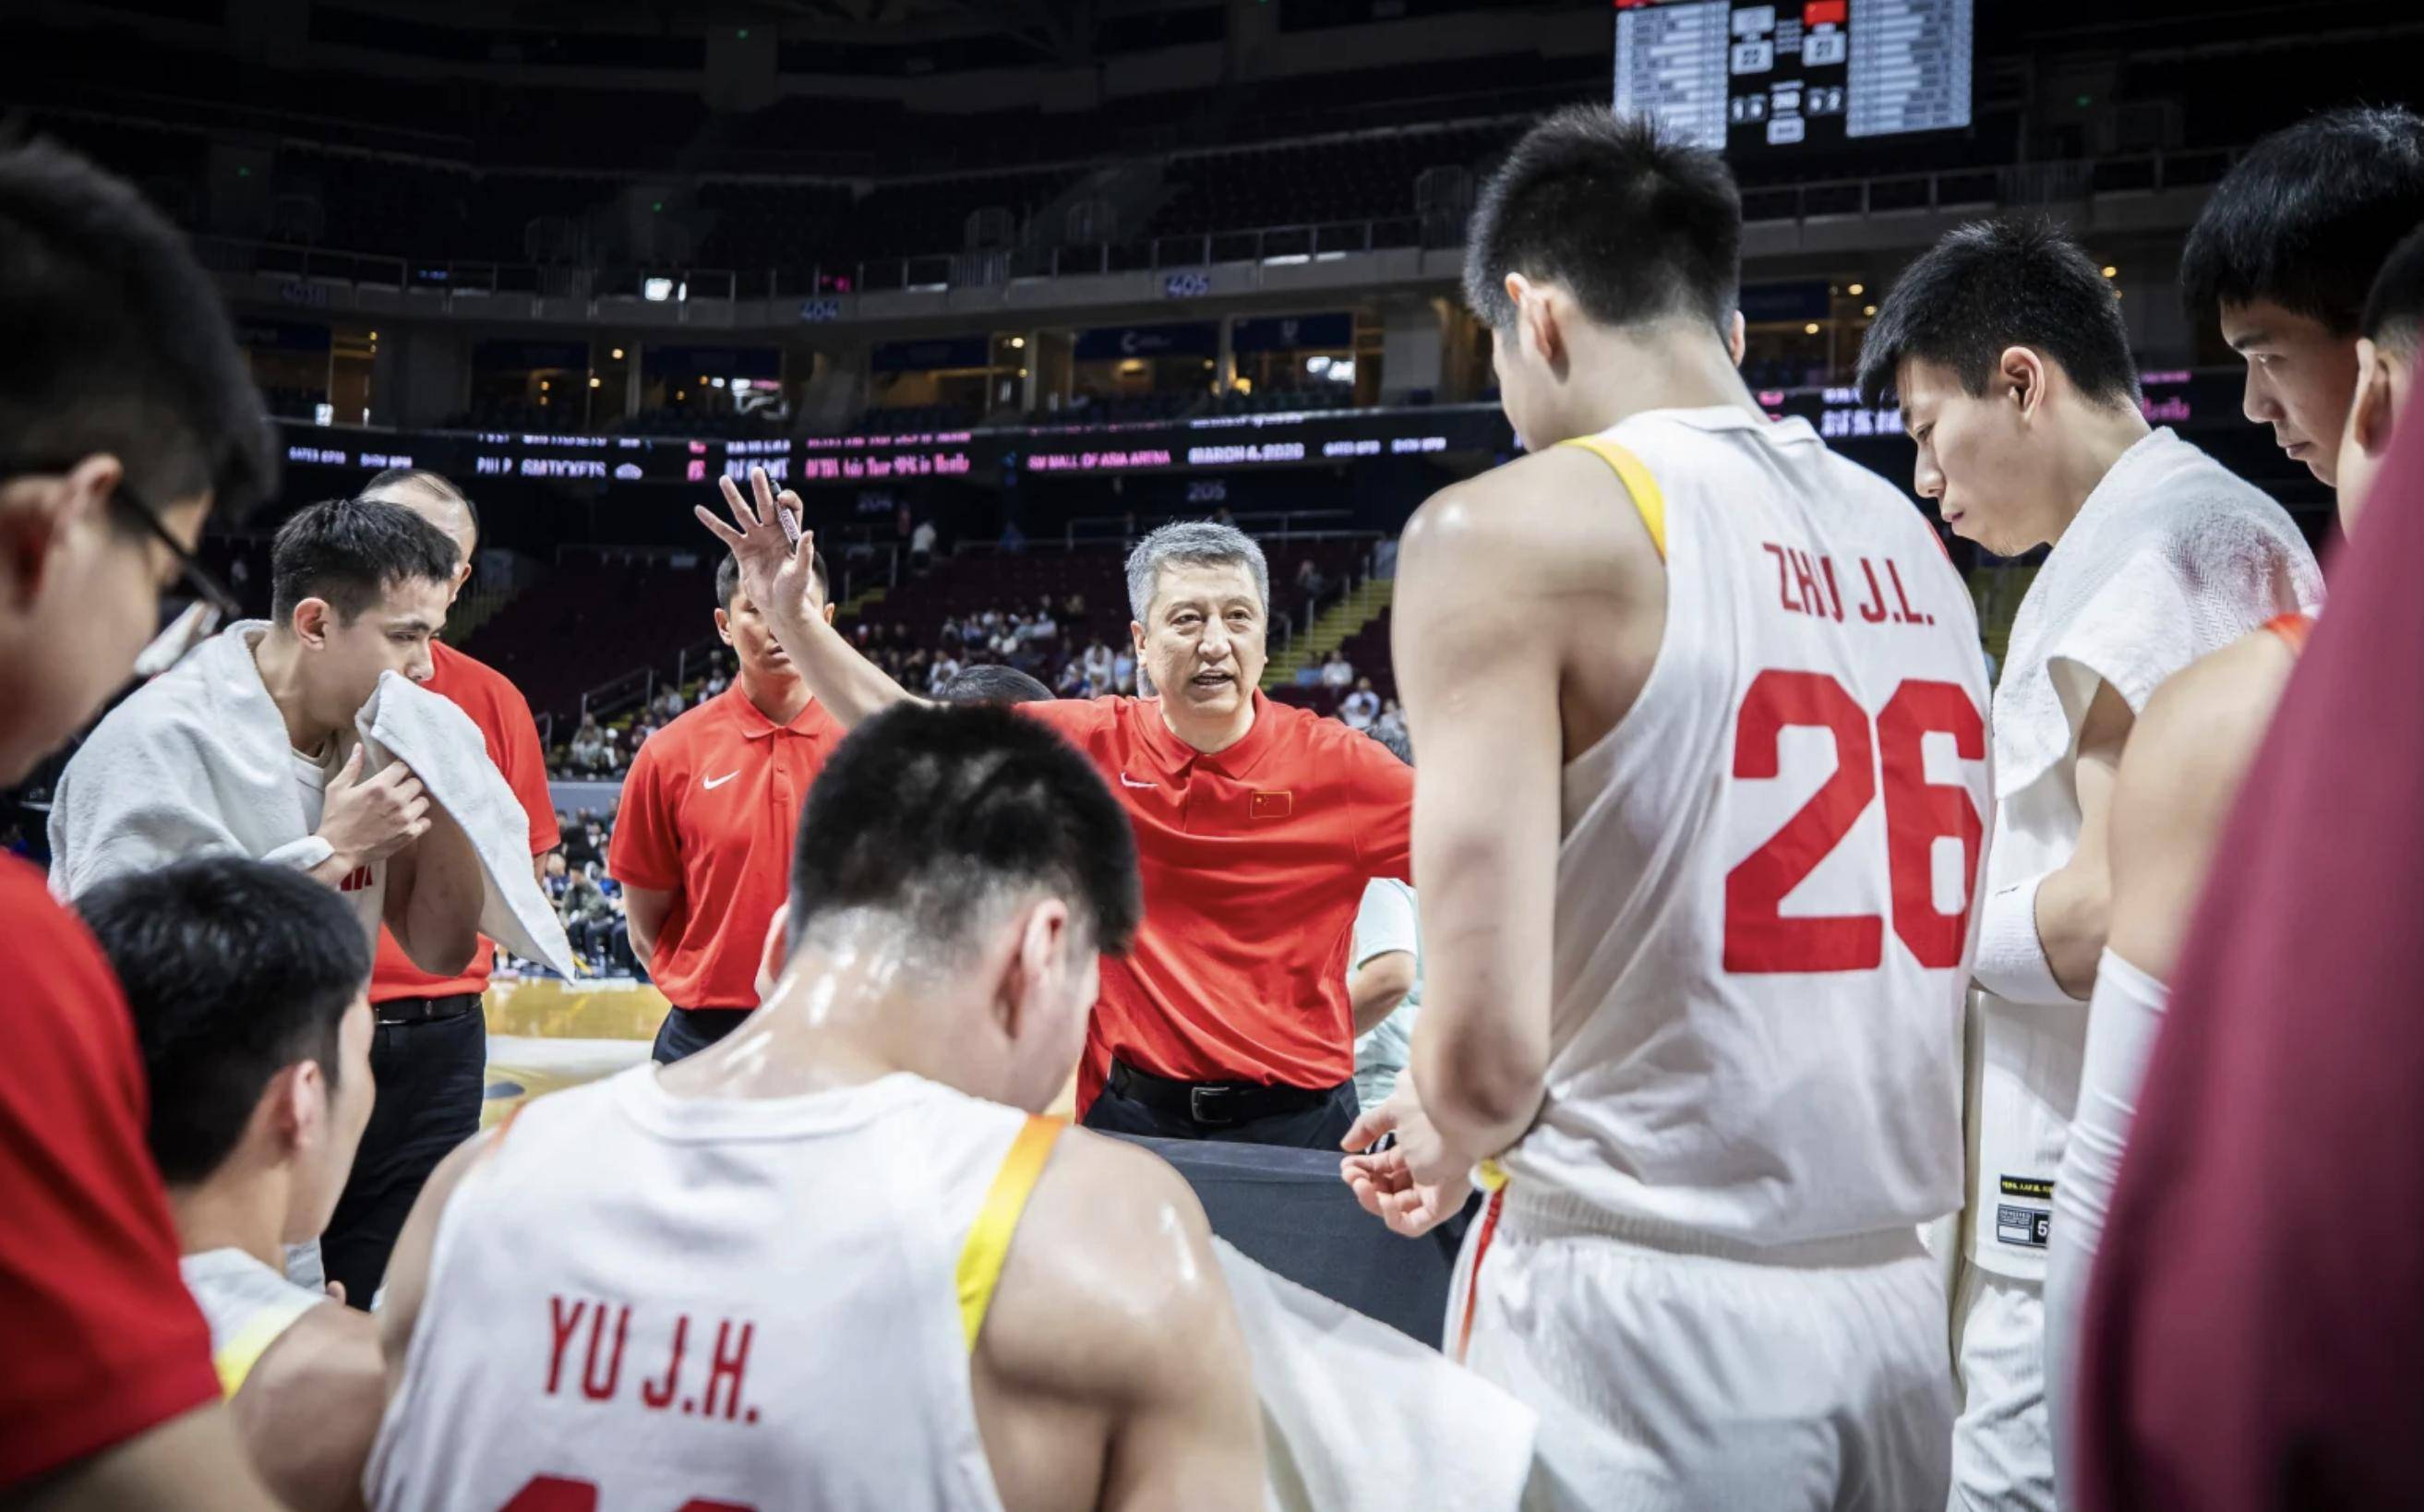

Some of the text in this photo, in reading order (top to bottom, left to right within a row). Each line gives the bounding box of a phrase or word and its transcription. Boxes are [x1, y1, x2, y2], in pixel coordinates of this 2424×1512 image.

[1169, 274, 1208, 296] 405
[1048, 454, 1077, 470] MALL
[1081, 452, 1098, 469] OF
[1100, 451, 1128, 467] ASIA
[1130, 449, 1170, 465] ARENA
[1188, 445, 1245, 464] MARCH
[1859, 557, 1936, 626] J.L.
[1722, 668, 1986, 974] 26
[545, 1294, 760, 1424] YU J.H.
